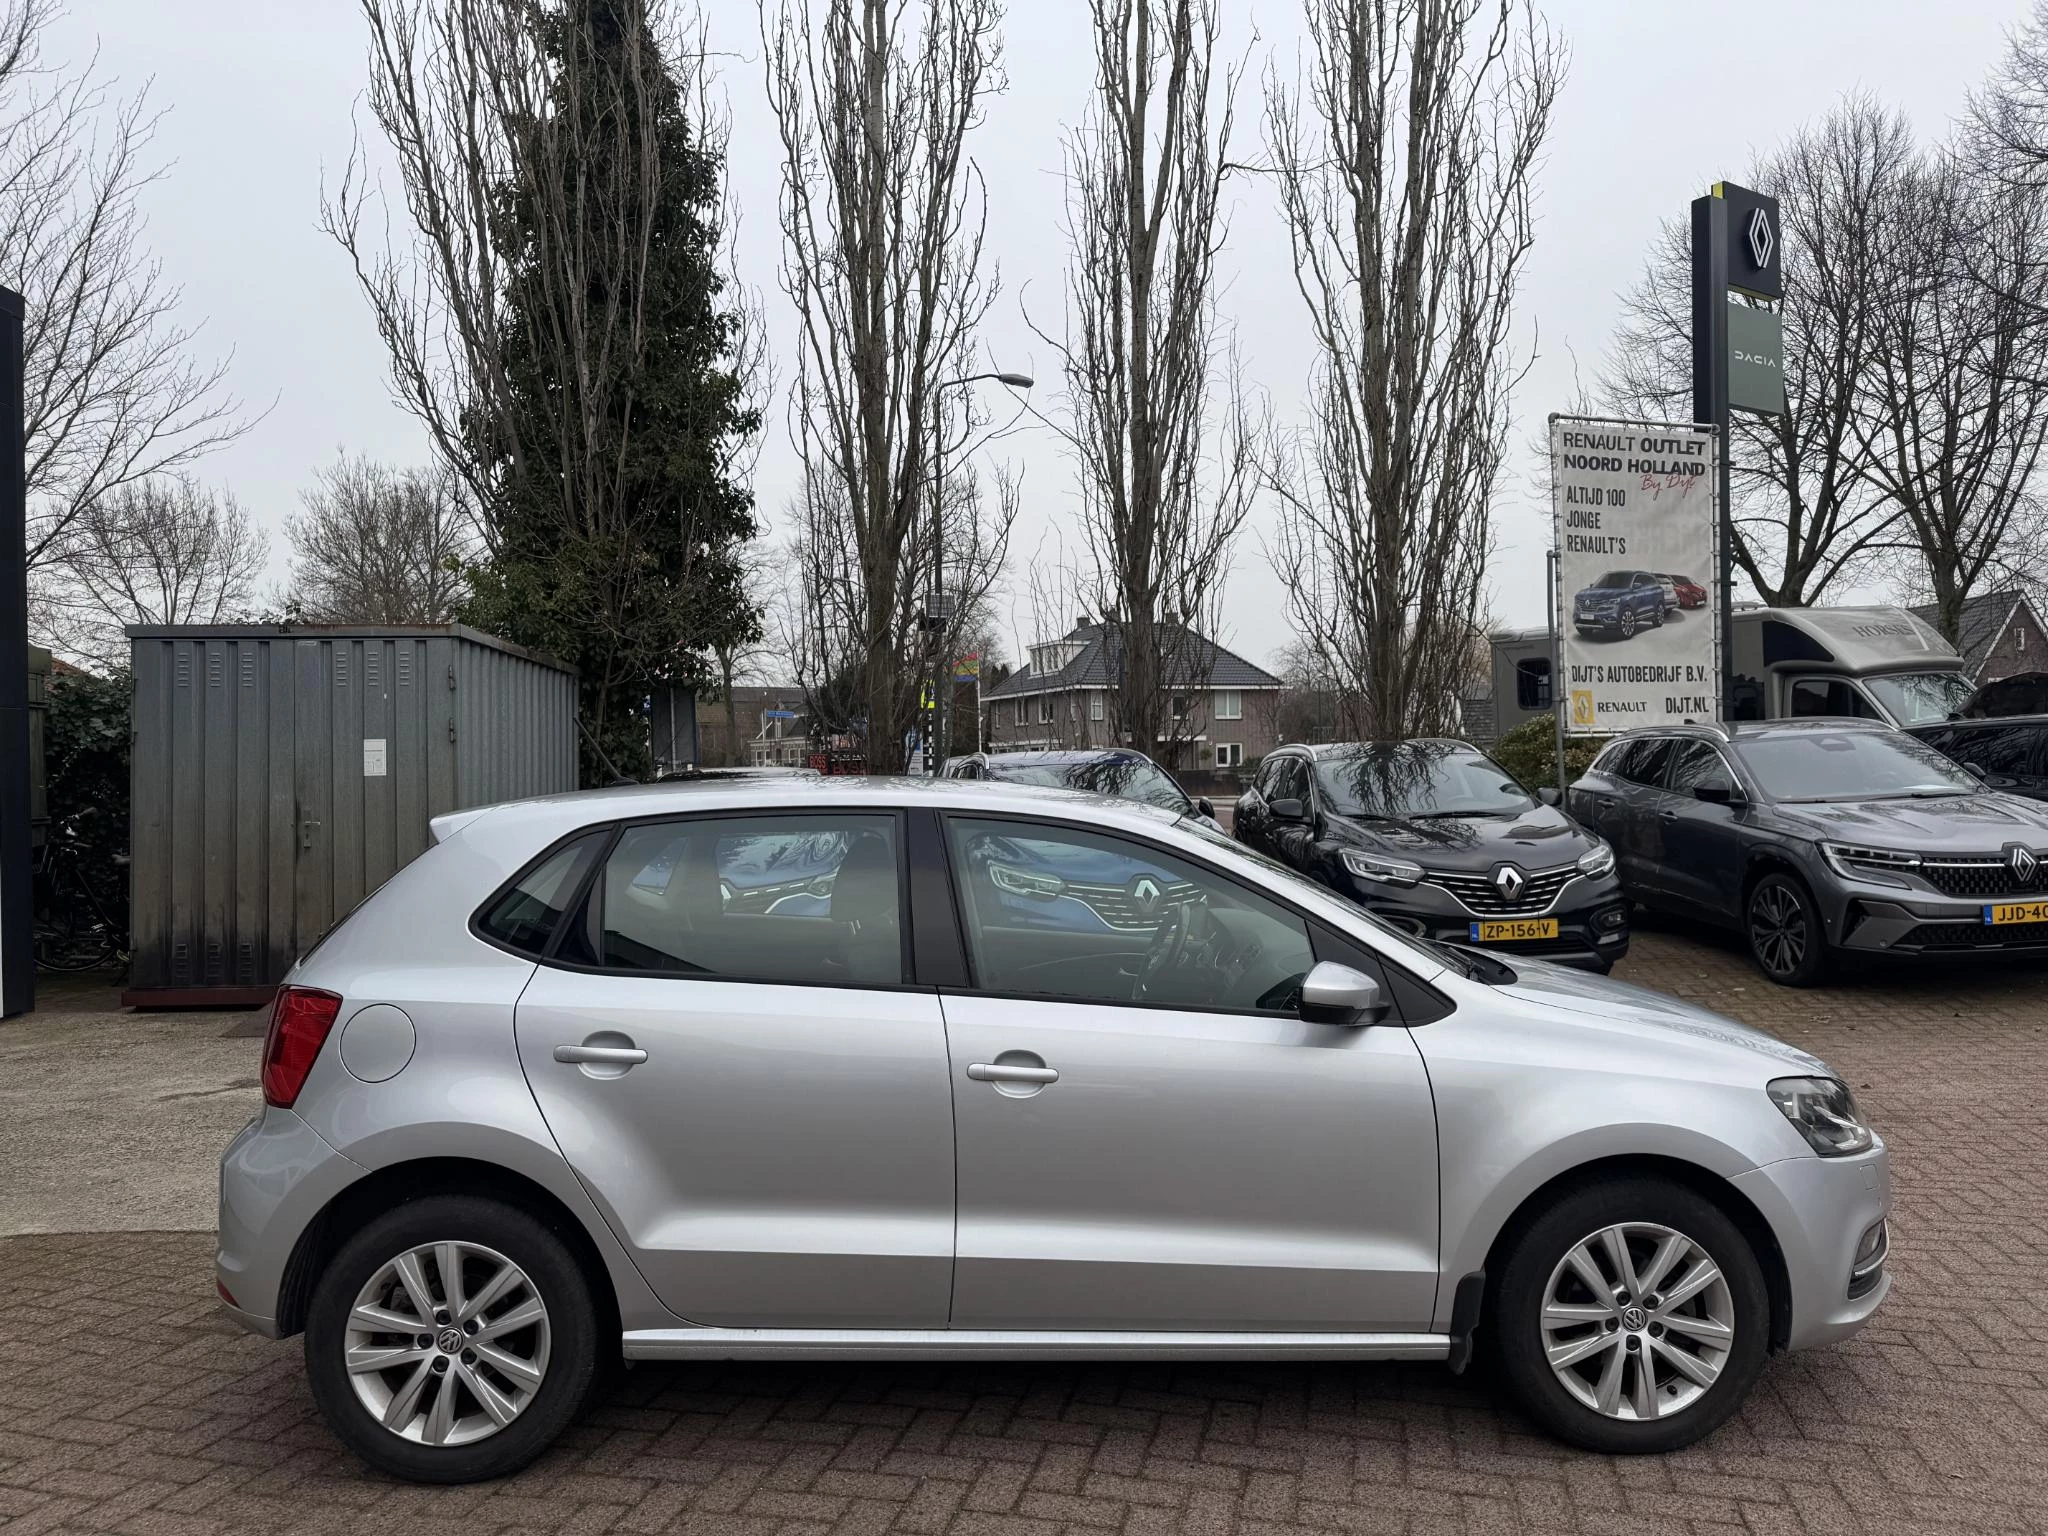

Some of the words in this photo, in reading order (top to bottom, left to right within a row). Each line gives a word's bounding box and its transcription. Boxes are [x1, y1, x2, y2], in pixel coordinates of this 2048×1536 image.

[1735, 350, 1776, 368] DACIA
[1563, 432, 1635, 451] RENAULT
[1640, 437, 1706, 456] OUTLET
[1563, 454, 1623, 472] NOORD
[1627, 458, 1705, 477] HOLLAND
[1567, 485, 1603, 506] ALTIJD
[1606, 488, 1626, 507] 100
[1640, 474, 1662, 500] By
[1567, 510, 1601, 529] JONGE
[1567, 534, 1626, 555] RENAULT'S
[1571, 665, 1604, 683] DIJT'S
[1607, 665, 1682, 683] AUTOBEDRIJF
[1686, 665, 1708, 682] B.V.
[1597, 701, 1647, 713] RENAULT
[1665, 696, 1709, 714] DIJT.NL
[1486, 922, 1551, 939] ZP-156-V
